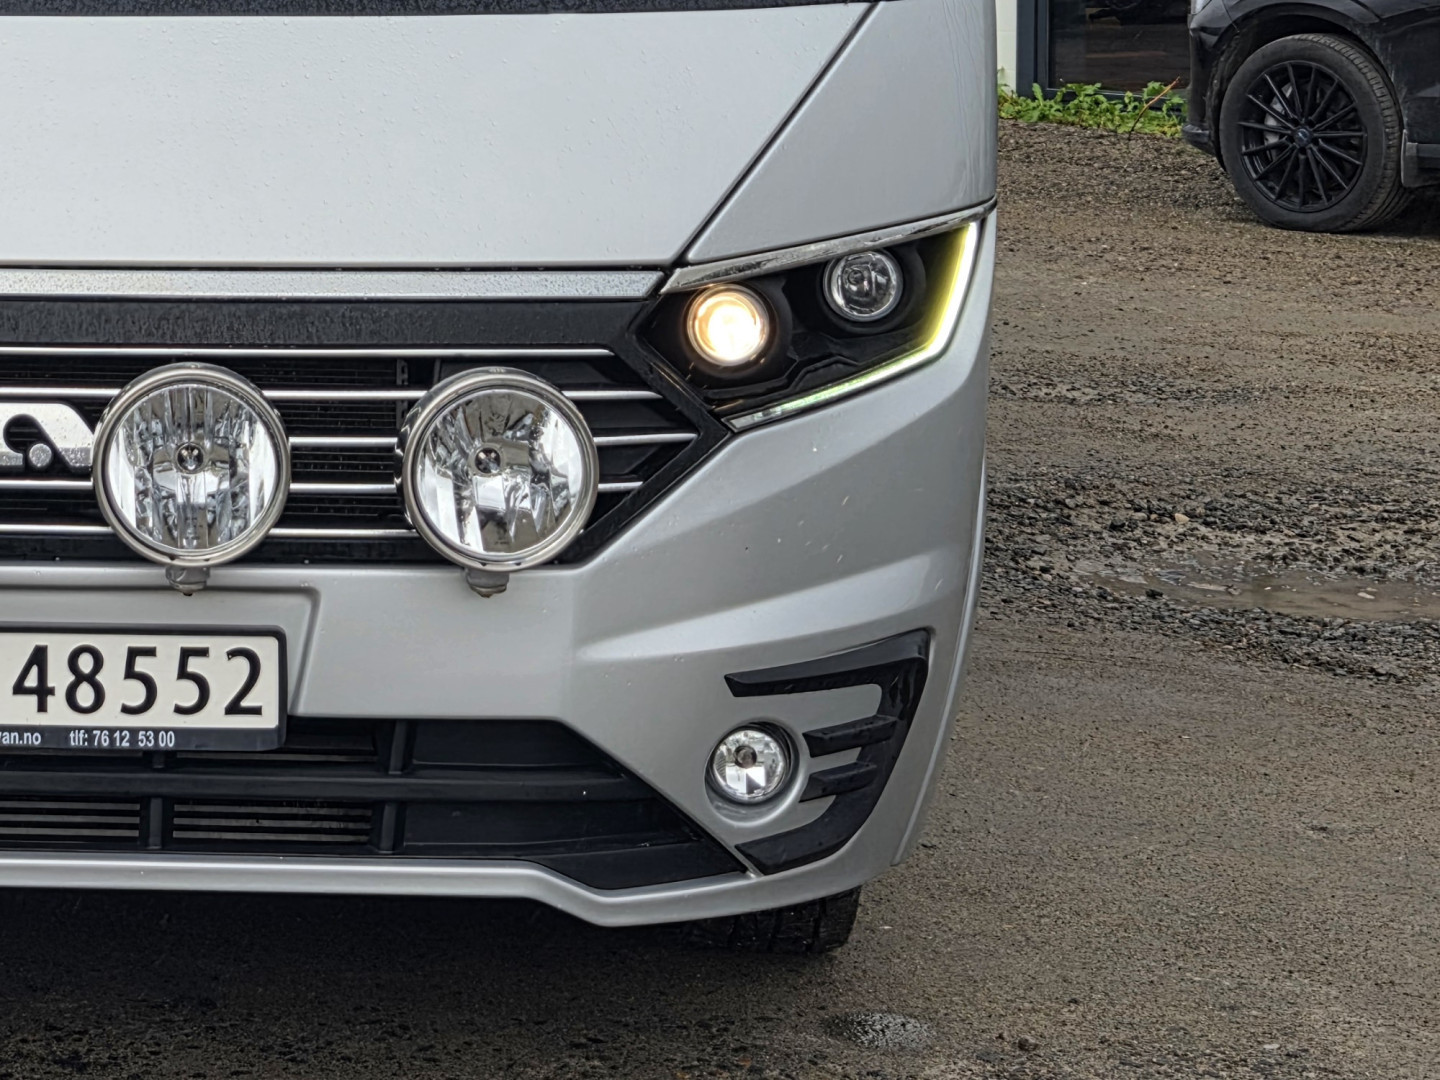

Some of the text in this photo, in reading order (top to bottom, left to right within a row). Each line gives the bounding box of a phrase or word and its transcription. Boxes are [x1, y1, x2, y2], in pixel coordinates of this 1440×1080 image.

[12, 643, 263, 717] 48552
[69, 730, 89, 747] tlf:
[92, 730, 110, 747] 76
[113, 731, 130, 748] 12
[138, 731, 155, 748] 53
[158, 731, 176, 748] 00
